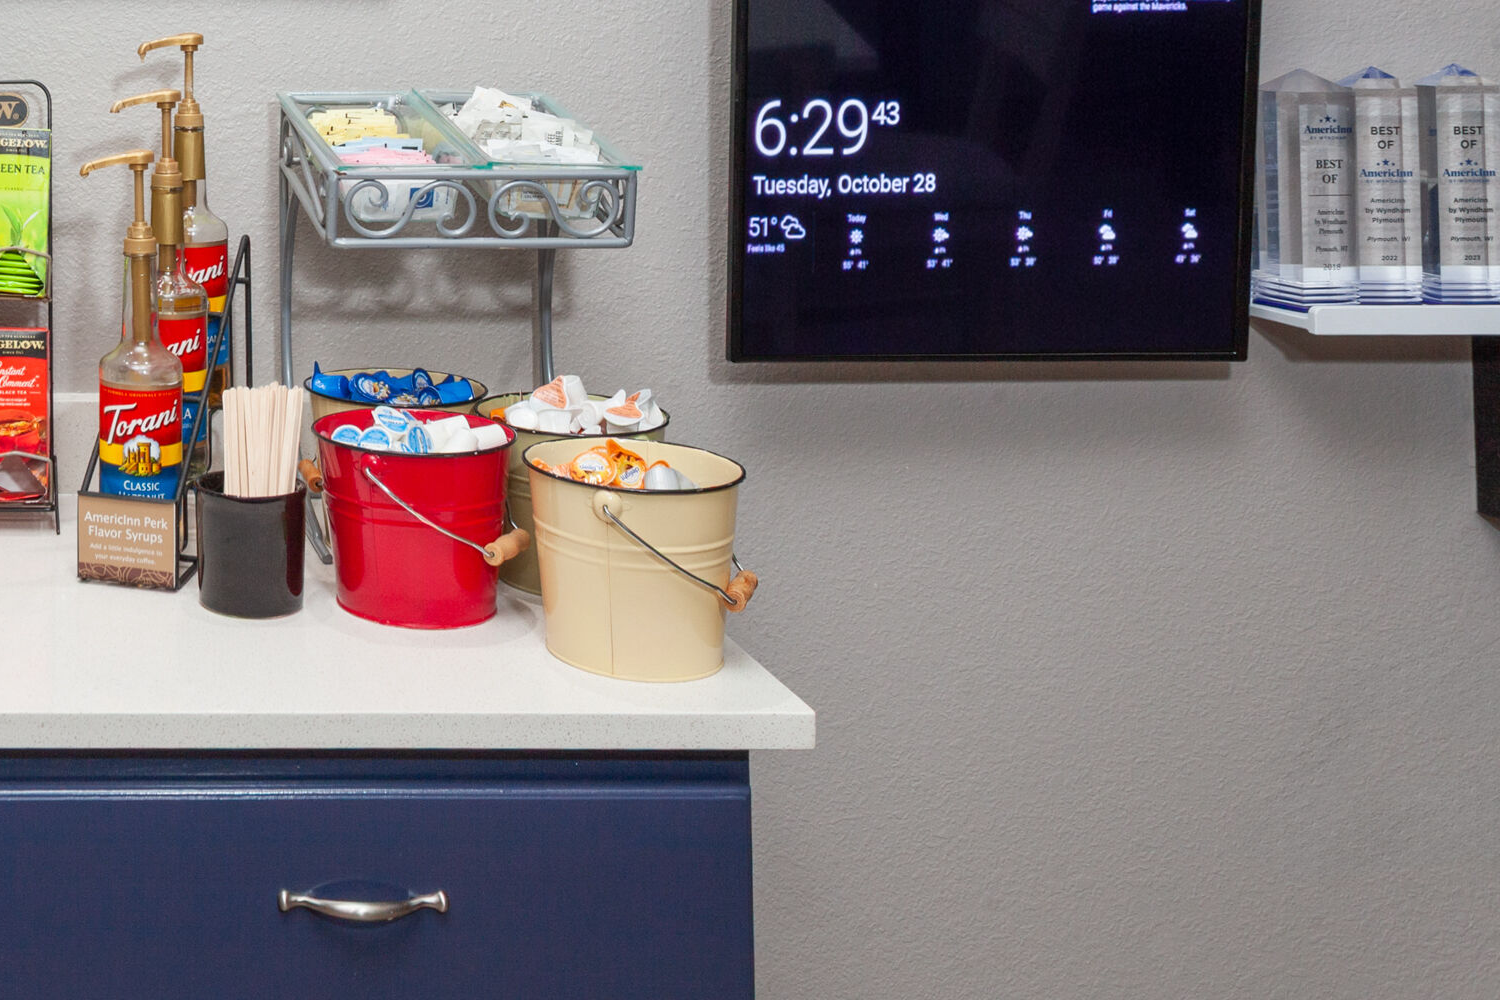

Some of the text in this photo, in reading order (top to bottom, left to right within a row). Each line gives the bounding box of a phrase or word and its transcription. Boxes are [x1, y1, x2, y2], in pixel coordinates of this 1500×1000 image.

[755, 98, 900, 157] 6:29 43
[1304, 125, 1353, 134] AmericInn
[1370, 126, 1400, 136] BEST
[1453, 126, 1484, 136] BEST
[1377, 140, 1395, 150] OF
[1460, 139, 1478, 149] OF
[1315, 159, 1344, 169] BEST
[25, 164, 46, 176] TEA
[1360, 168, 1414, 178] AmericInn
[1442, 168, 1497, 178] AmericInn
[1322, 173, 1339, 184] OF
[753, 173, 936, 199] Tuesday, October 28
[104, 399, 178, 445] Torani
[123, 480, 160, 491] CLASSIC
[84, 511, 168, 530] AmericInn Perk
[88, 525, 163, 545] Flavor Syrups
[109, 555, 136, 563] everyday
